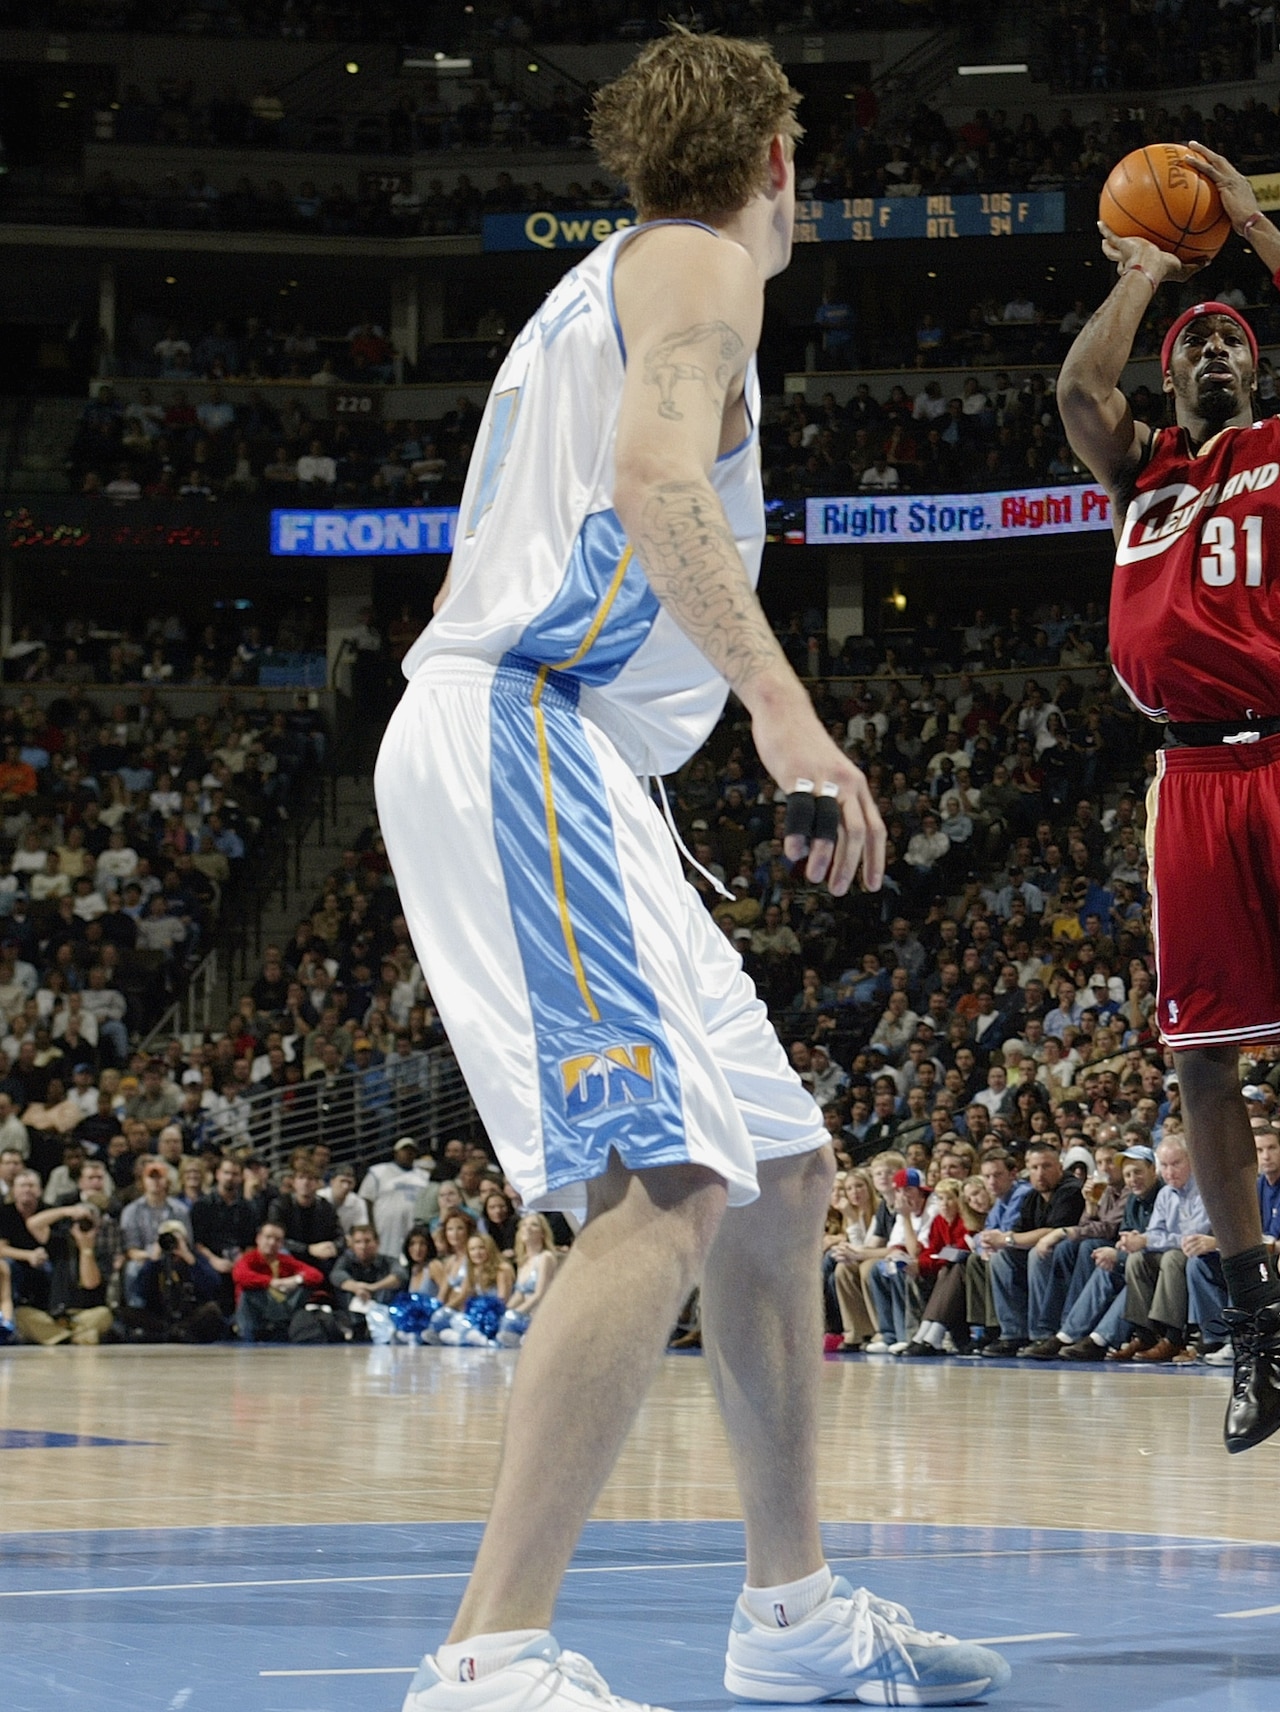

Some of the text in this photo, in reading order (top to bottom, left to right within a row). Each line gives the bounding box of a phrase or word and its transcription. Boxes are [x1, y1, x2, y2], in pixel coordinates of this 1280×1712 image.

[842, 198, 874, 219] 100
[879, 207, 891, 228] F
[1018, 202, 1029, 223] F
[852, 221, 874, 241] 91
[926, 218, 959, 238] ATL
[823, 503, 898, 537] Right
[908, 501, 991, 535] Store.
[1200, 515, 1264, 588] 31
